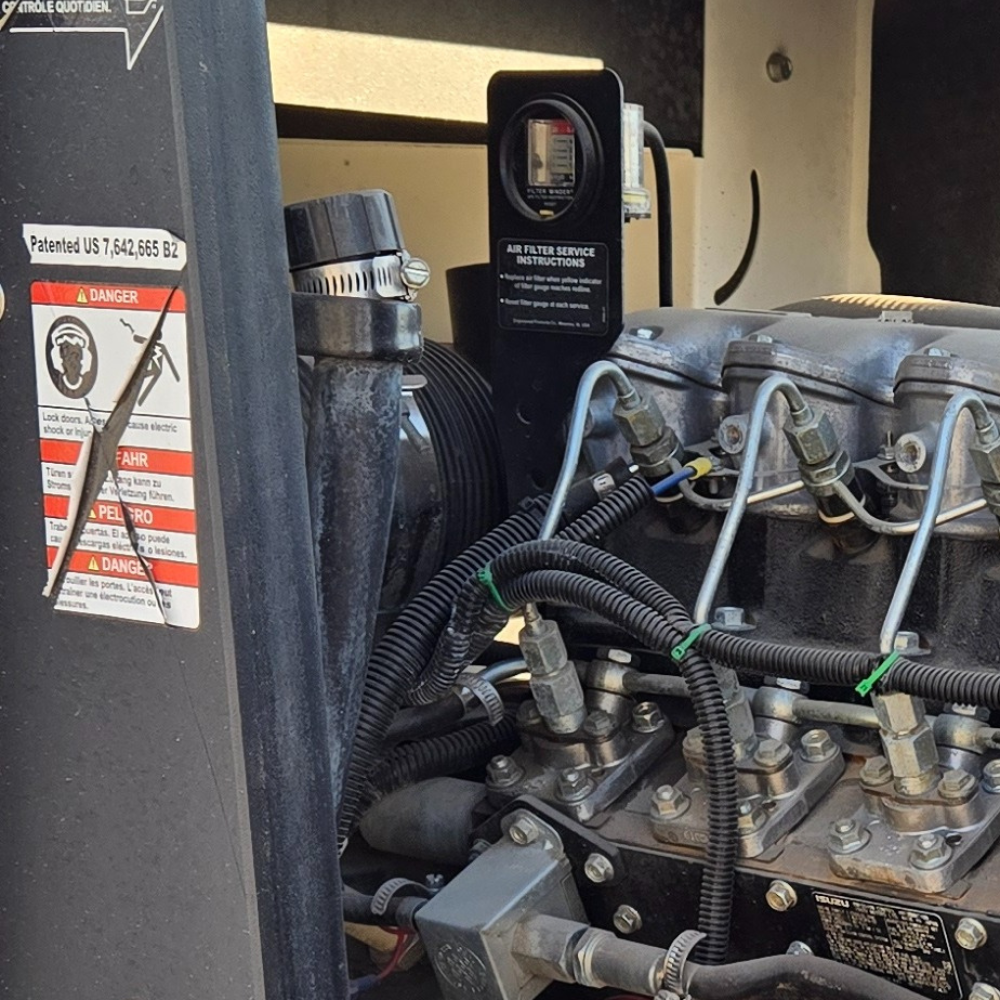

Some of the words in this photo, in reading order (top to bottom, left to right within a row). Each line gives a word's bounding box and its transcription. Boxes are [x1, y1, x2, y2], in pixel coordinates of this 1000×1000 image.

[55, 0, 112, 13] QUOTIDIEN.
[30, 235, 80, 255] Patented
[83, 239, 100, 255] US
[103, 238, 160, 260] 7,642,665
[163, 241, 178, 260] B2
[506, 244, 522, 254] AIR
[524, 245, 554, 256] FILTER
[556, 246, 596, 257] SERVICE
[516, 256, 586, 268] INSTRUCTIONS
[90, 288, 138, 304] DANGER
[42, 412, 59, 422] Lock
[61, 414, 82, 424] doors.
[151, 422, 177, 432] electric
[44, 425, 64, 434] shock
[98, 505, 153, 524] PELGRO
[815, 894, 850, 908] ISUZU
